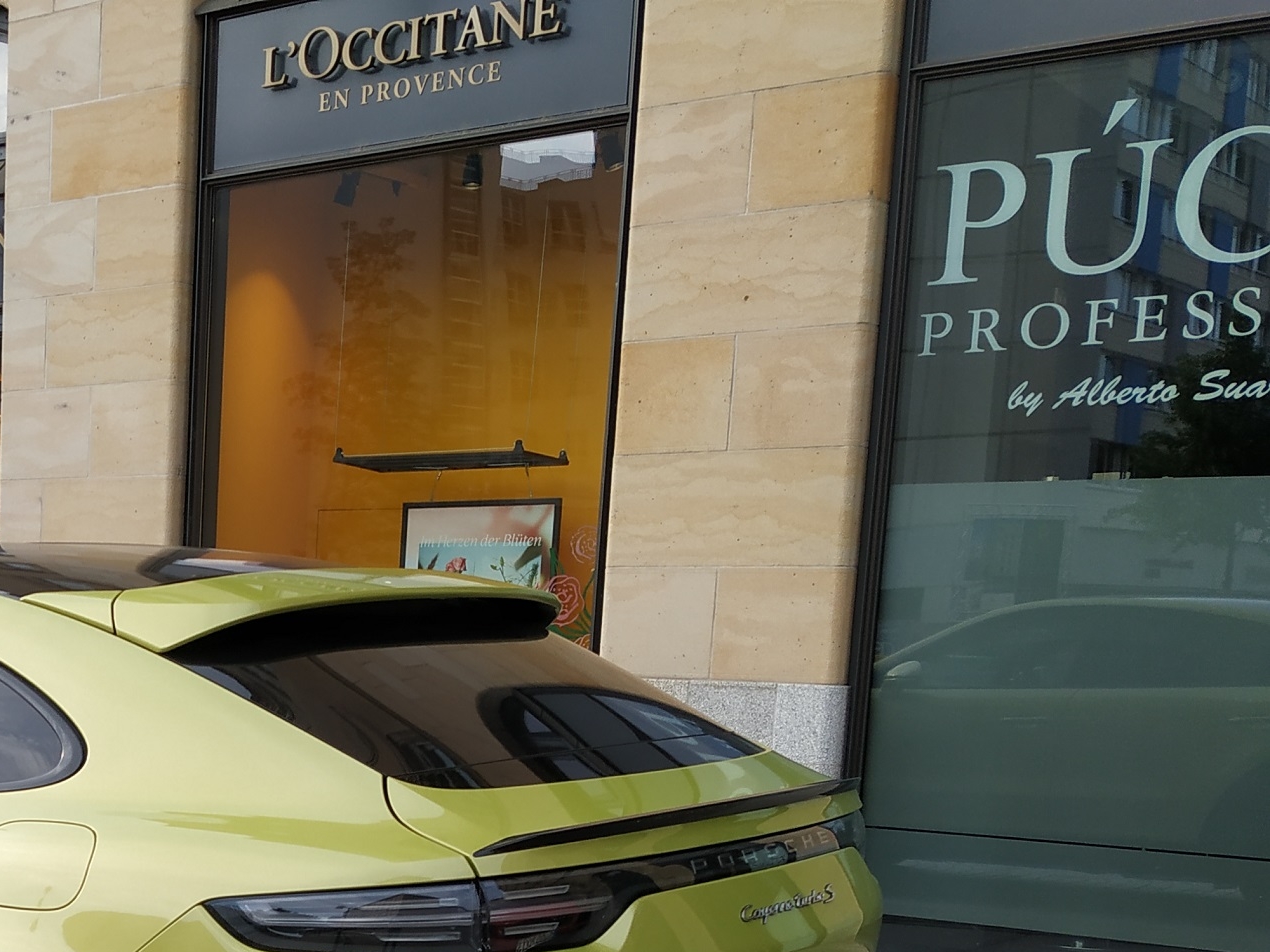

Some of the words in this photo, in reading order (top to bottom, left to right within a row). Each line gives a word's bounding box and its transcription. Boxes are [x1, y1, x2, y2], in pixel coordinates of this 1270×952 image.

[261, 0, 560, 89] L'OCCITANE
[318, 88, 351, 113] EN
[360, 60, 503, 106] PROVENCE
[918, 286, 1262, 357] PROFESS
[1007, 380, 1044, 417] by
[1051, 374, 1181, 411] Alberto
[1192, 368, 1270, 401] Sua
[437, 535, 478, 548] Herzen
[480, 533, 501, 548] der
[503, 532, 543, 547] Blüten
[690, 830, 829, 875] PORSCHE
